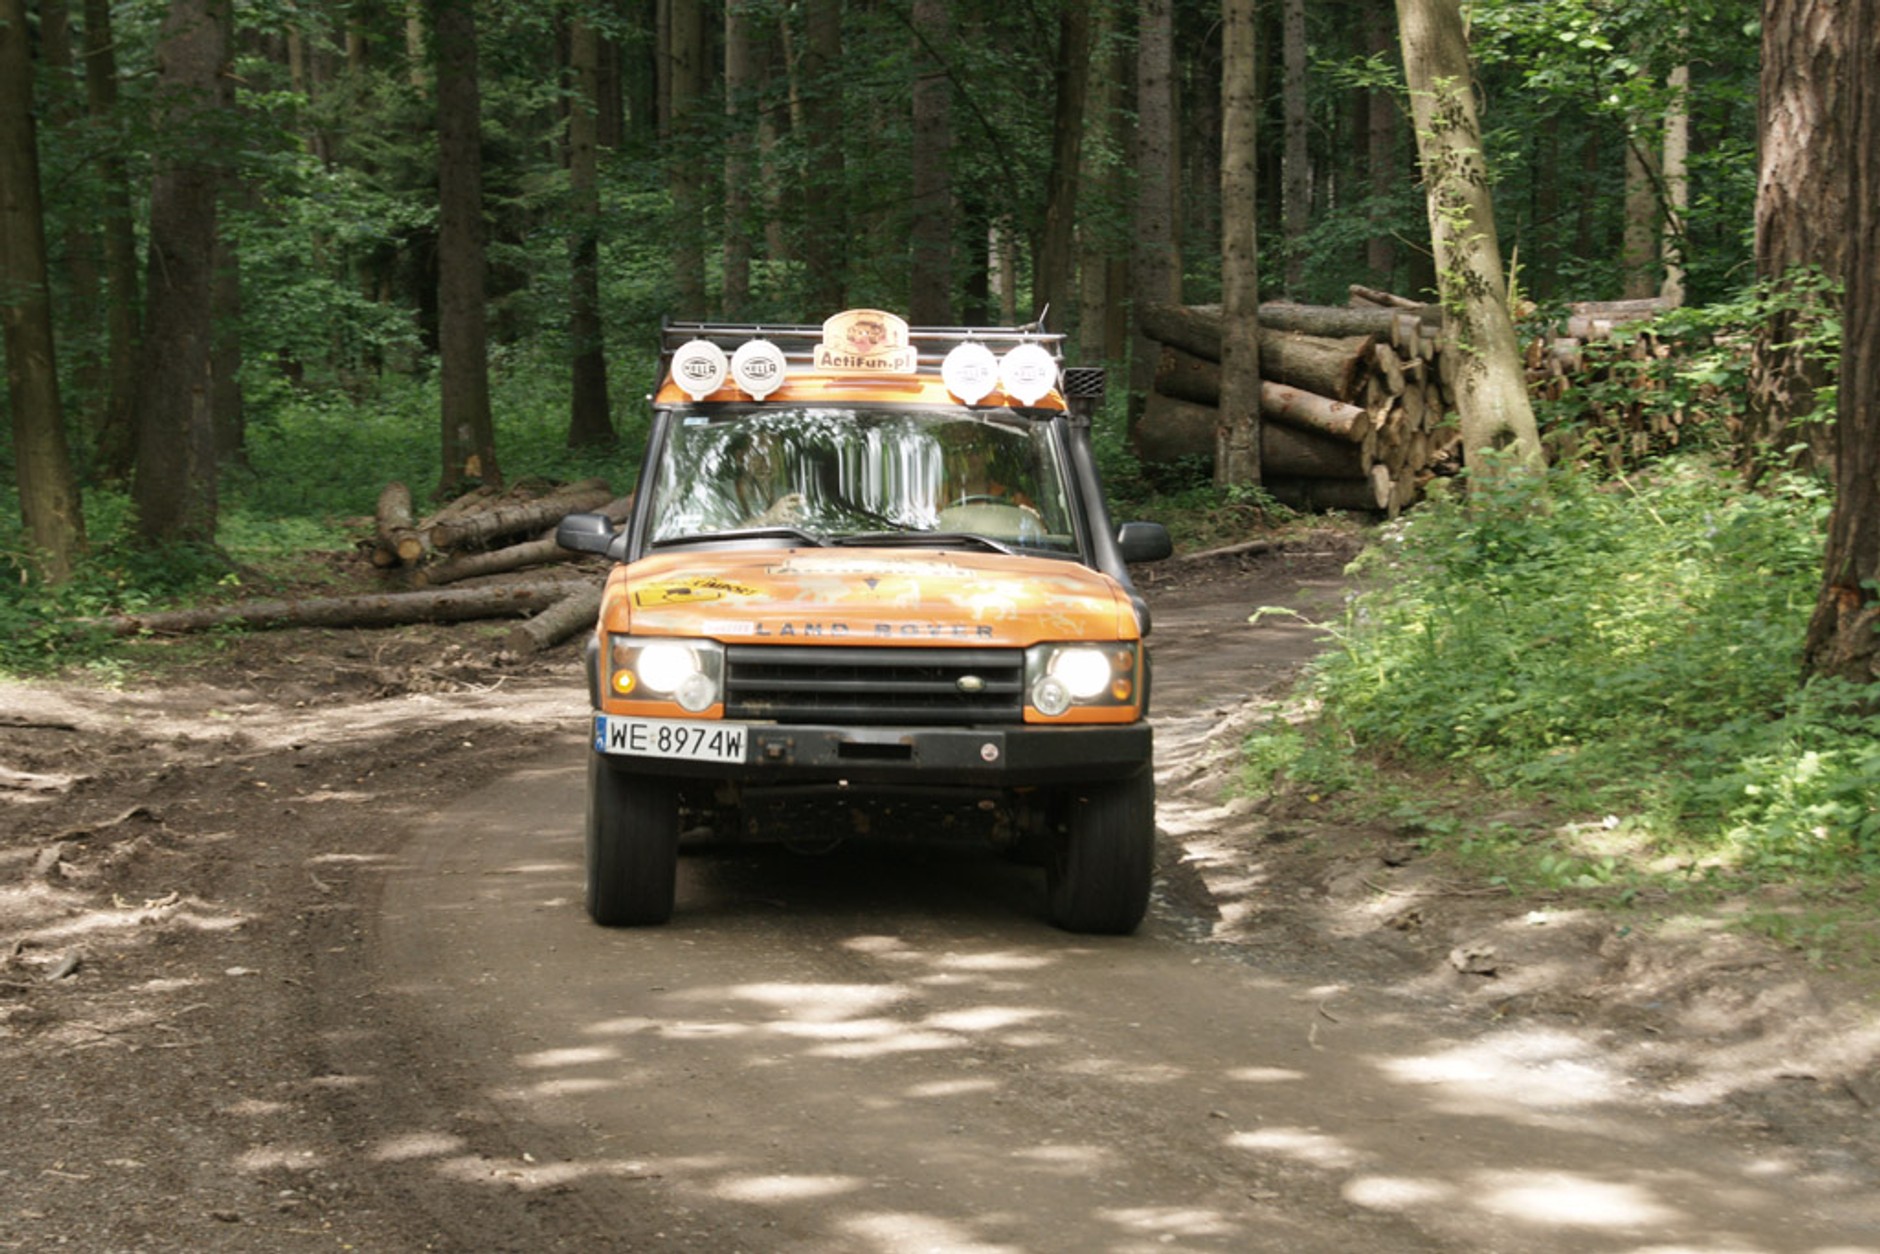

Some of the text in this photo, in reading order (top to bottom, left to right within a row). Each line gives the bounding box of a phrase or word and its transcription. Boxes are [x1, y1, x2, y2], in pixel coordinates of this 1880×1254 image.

[755, 622, 849, 637] LAND
[874, 623, 994, 639] ROVER
[610, 721, 742, 758] WE 8974W
